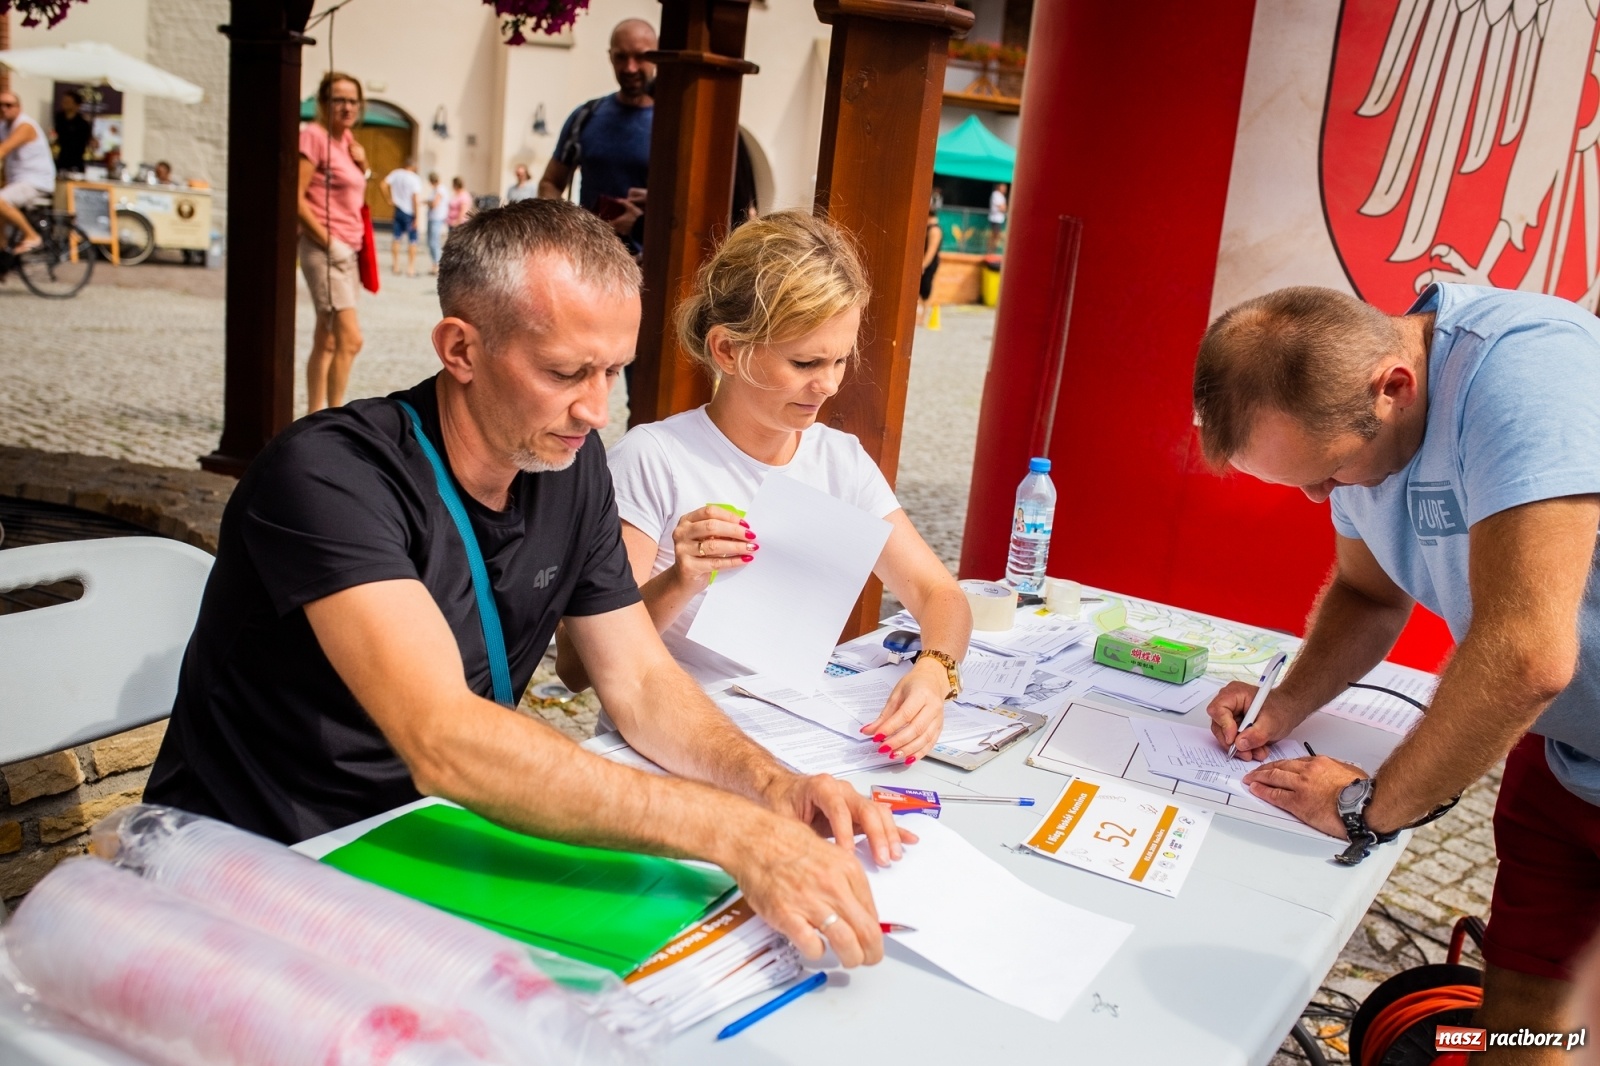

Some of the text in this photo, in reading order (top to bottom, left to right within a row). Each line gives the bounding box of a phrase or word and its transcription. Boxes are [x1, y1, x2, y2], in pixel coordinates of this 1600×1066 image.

[1418, 498, 1456, 530] PURE
[533, 565, 558, 589] 4F
[1048, 828, 1065, 842] Bieg
[1068, 792, 1088, 814] Komina
[1093, 821, 1137, 848] 52
